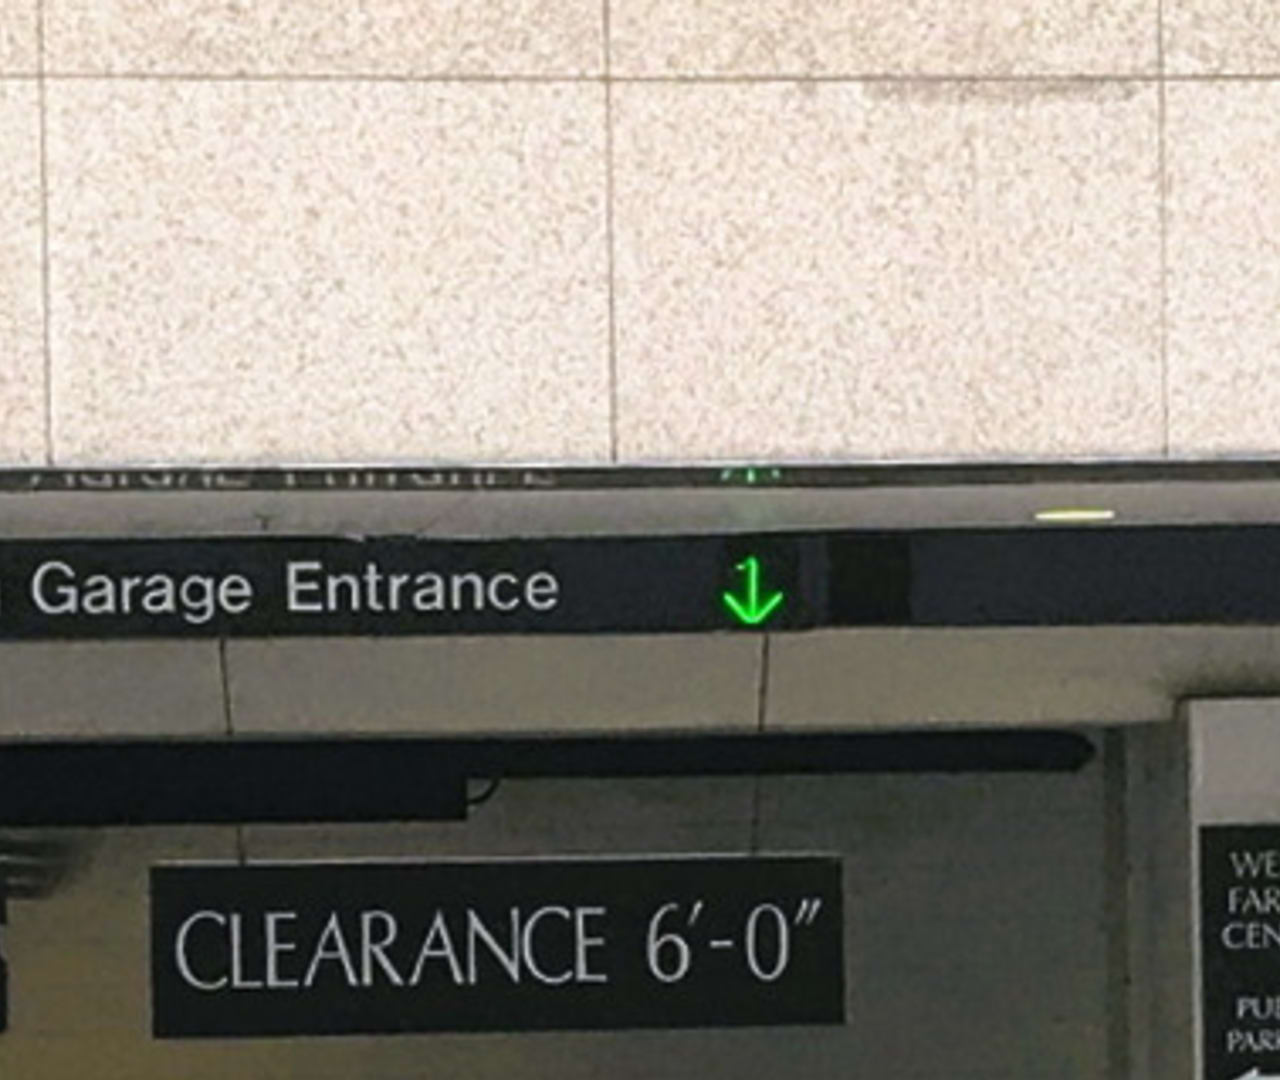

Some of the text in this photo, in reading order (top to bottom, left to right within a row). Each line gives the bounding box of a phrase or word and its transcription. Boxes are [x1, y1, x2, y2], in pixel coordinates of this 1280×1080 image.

[32, 562, 251, 623] Garage
[288, 562, 557, 611] Entrance
[176, 907, 606, 989] CLEARANCE
